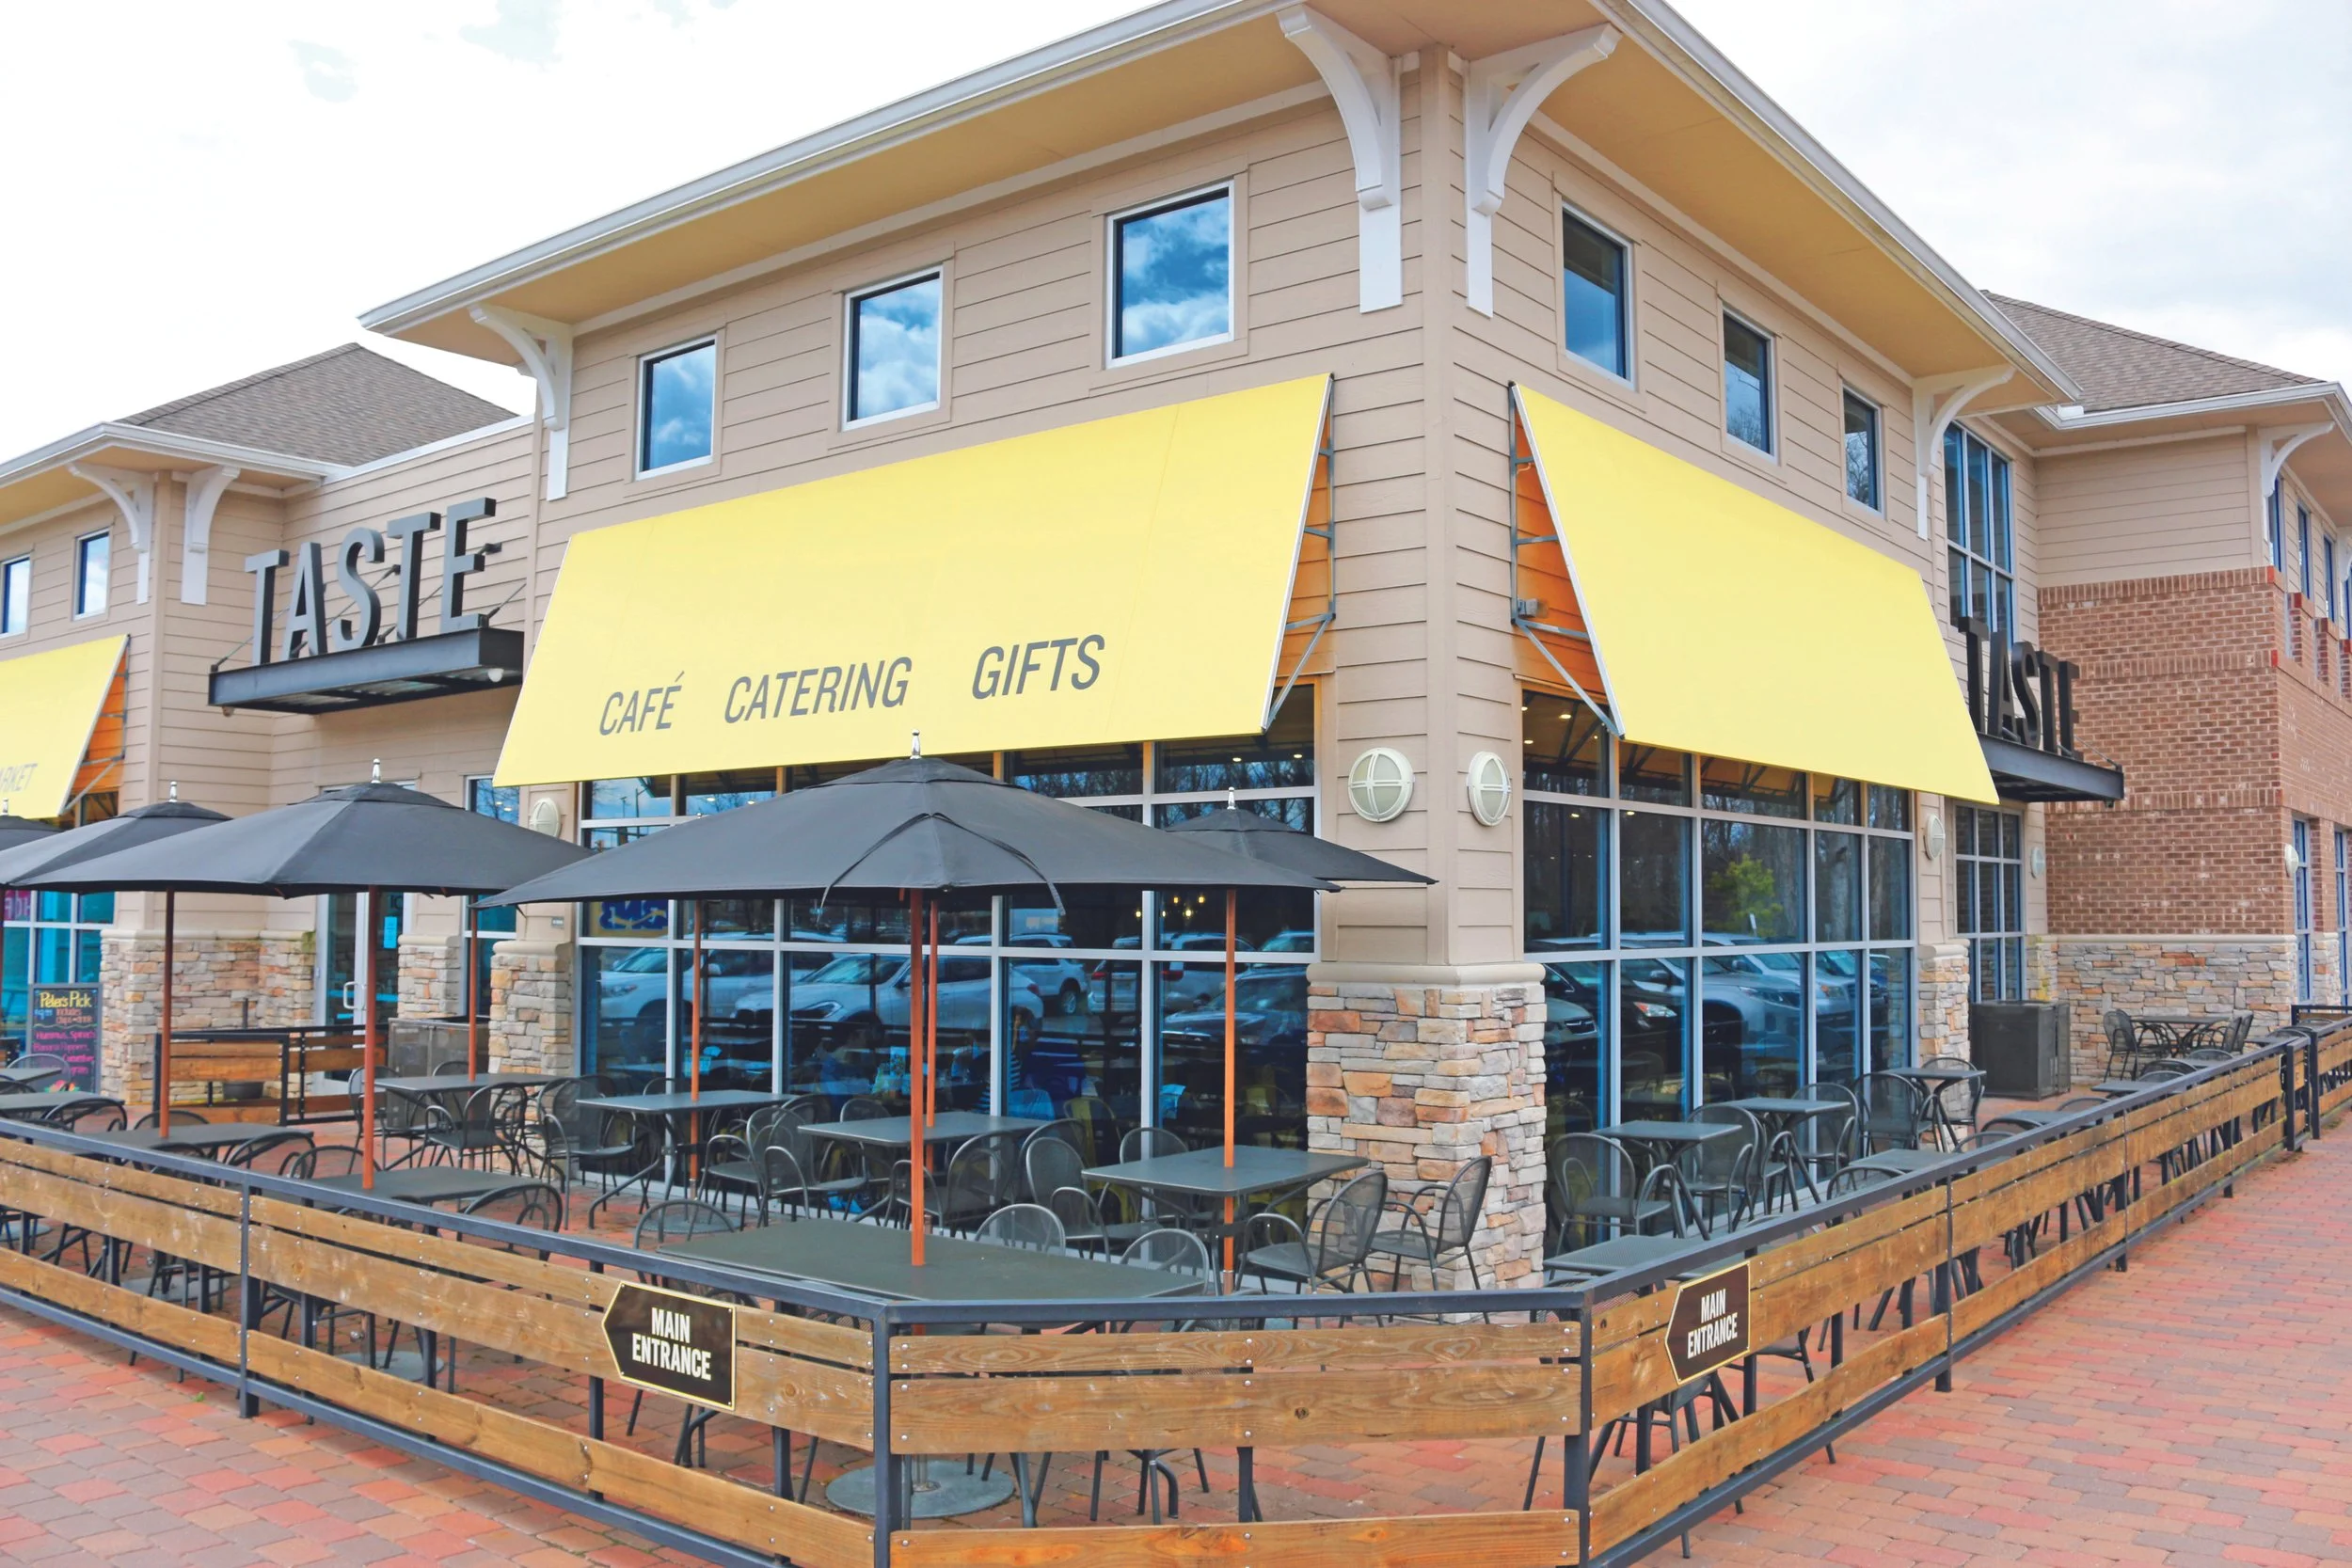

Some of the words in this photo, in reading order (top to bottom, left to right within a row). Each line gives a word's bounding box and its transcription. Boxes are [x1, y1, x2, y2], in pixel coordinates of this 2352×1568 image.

[245, 497, 496, 666] TASTE
[599, 671, 685, 736] CAFÉ
[724, 657, 913, 724] CATERING
[972, 634, 1105, 700] GIFTS
[1958, 616, 2084, 762] TASTE
[651, 1307, 691, 1344] MAIN
[1701, 1288, 1725, 1323] MAIN
[632, 1332, 711, 1381] ENTRANCE
[1687, 1312, 1738, 1359] ENTRANCE
